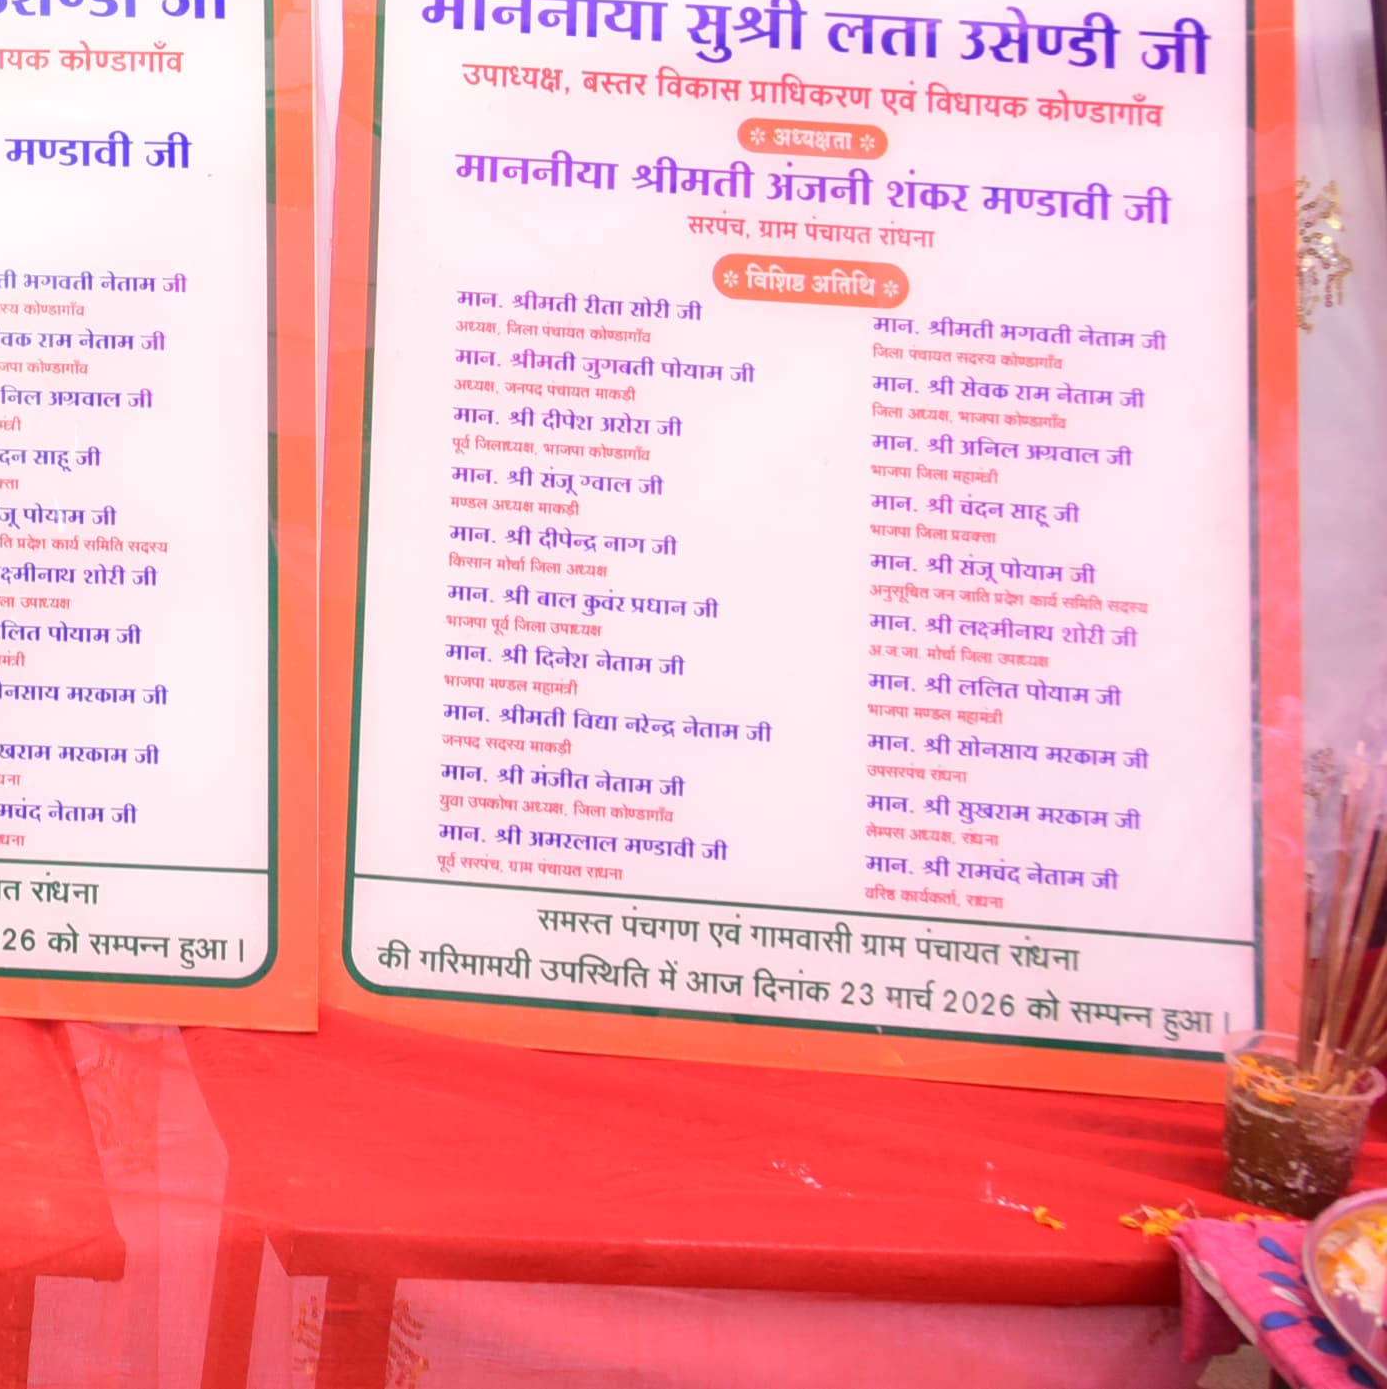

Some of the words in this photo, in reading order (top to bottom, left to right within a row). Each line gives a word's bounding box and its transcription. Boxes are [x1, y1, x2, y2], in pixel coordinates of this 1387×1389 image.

[58, 40, 184, 73] कोण्डागाँव
[824, 12, 942, 58] लता
[959, 6, 1121, 69] उसेण्डी
[1139, 17, 1211, 74] जी
[377, 939, 411, 970] की
[419, 943, 532, 979] गरिमामयी
[539, 953, 650, 988] उपस्थिति
[658, 959, 678, 991] में
[686, 970, 744, 996] आज
[752, 967, 831, 1002] दिनांक
[840, 981, 874, 1006] 23
[885, 979, 935, 1011] मार्च
[943, 989, 1015, 1017] 2026
[1026, 989, 1060, 1021] को
[1068, 1001, 1153, 1028] सम्पन्न
[1162, 1008, 1212, 1041] हुआ
